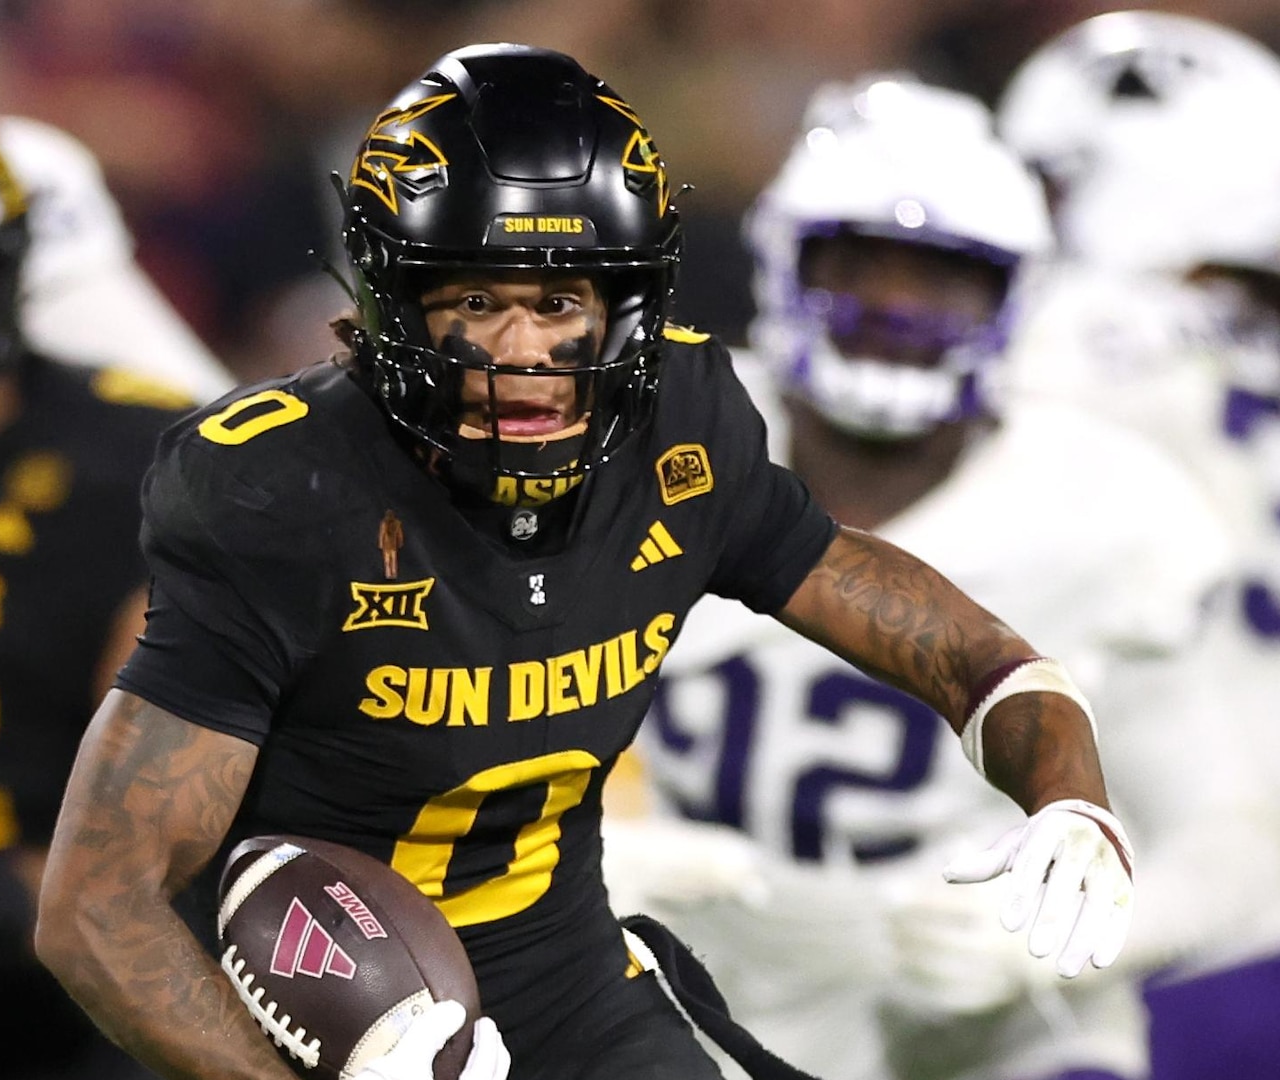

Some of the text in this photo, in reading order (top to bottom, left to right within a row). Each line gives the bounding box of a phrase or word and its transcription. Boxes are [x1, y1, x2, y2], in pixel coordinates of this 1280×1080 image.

[504, 217, 583, 234] SUN DEVILS
[198, 389, 310, 446] 0
[358, 612, 676, 727] SUN DEVILS
[653, 652, 942, 862] 92
[391, 749, 602, 928] 0
[323, 881, 389, 940] DIME
